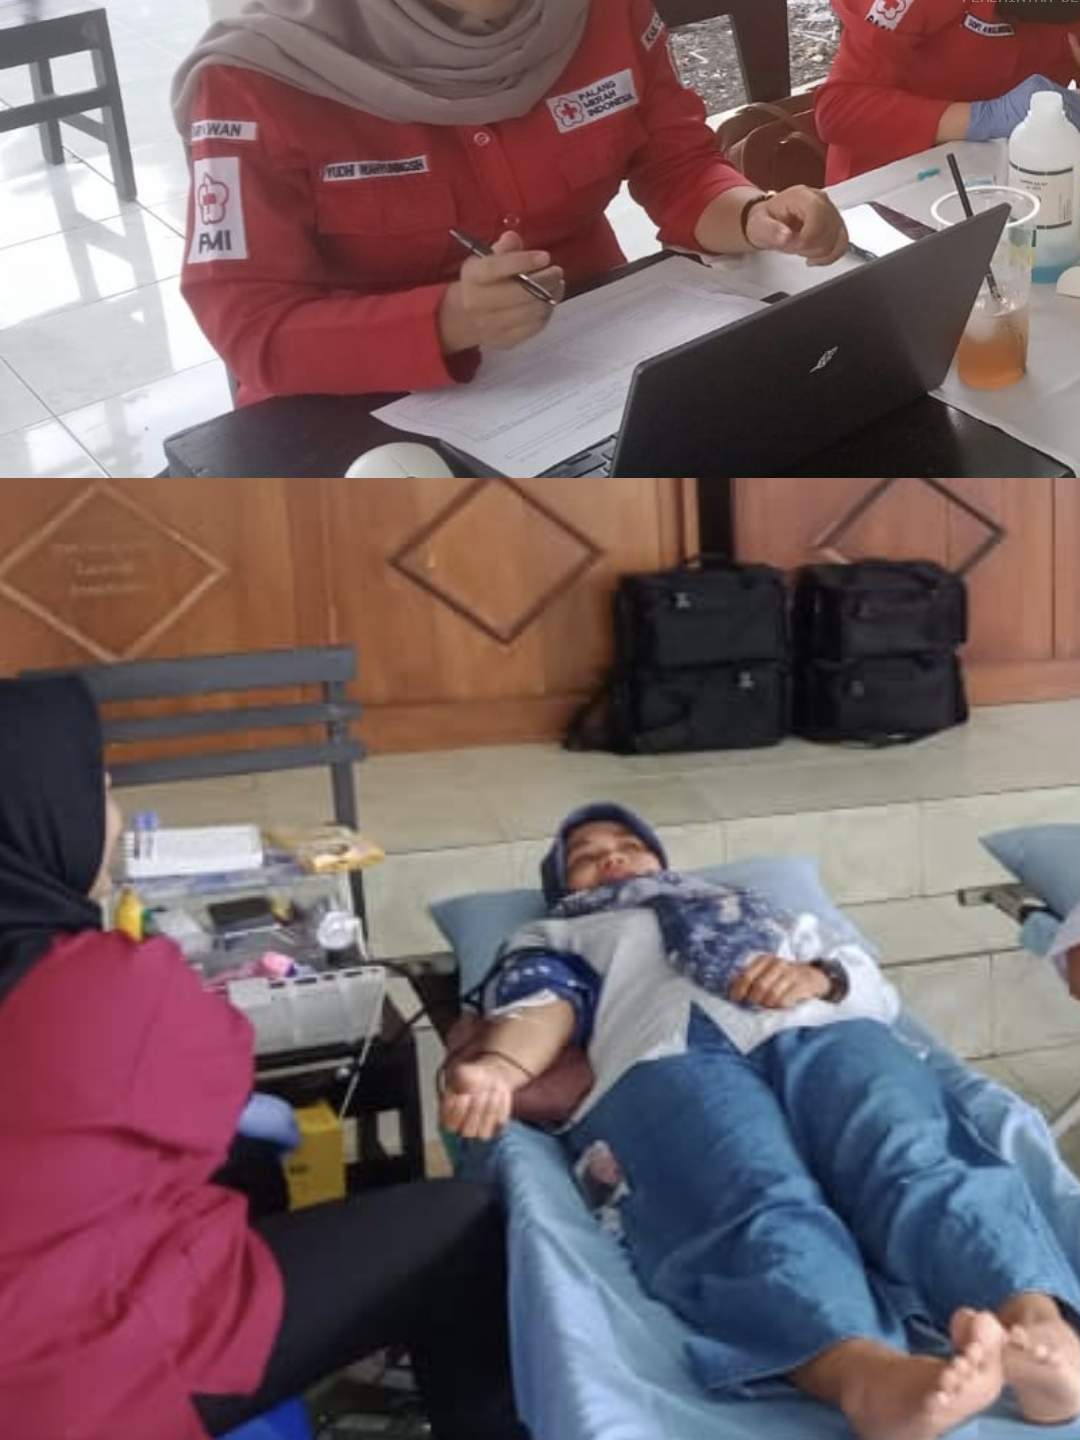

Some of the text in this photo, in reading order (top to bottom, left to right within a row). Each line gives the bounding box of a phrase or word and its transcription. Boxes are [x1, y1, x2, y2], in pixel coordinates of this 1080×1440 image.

[578, 80, 617, 101] PALANG
[583, 89, 617, 108] MERAH
[587, 93, 634, 116] INDONESIA
[198, 229, 232, 255] PMI
